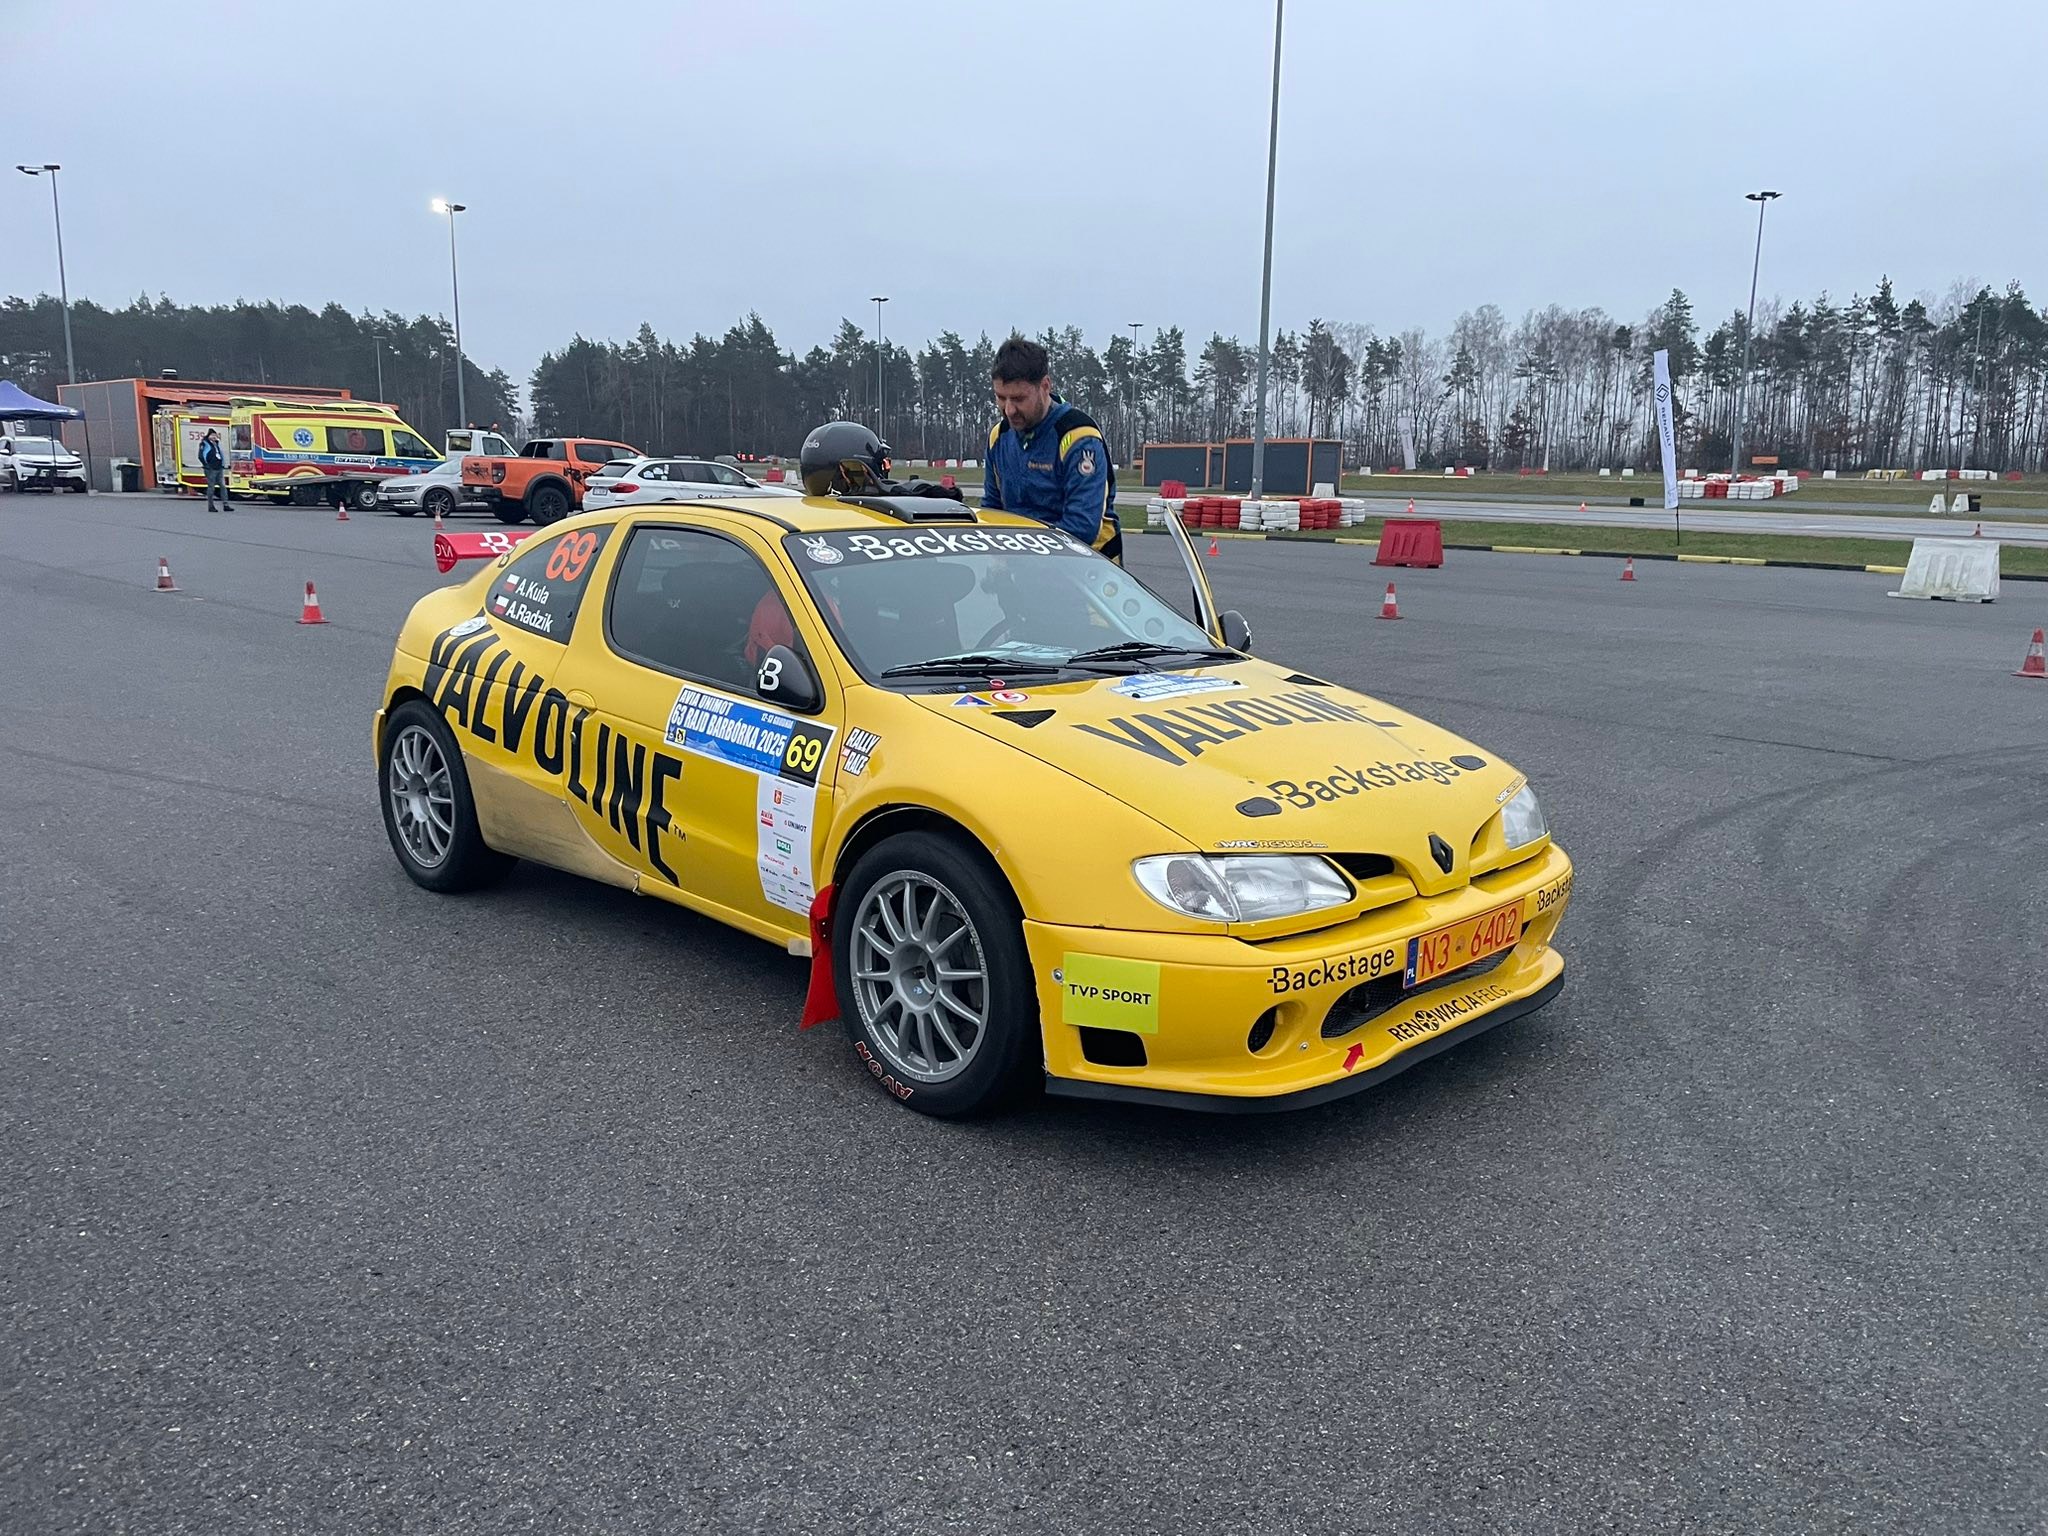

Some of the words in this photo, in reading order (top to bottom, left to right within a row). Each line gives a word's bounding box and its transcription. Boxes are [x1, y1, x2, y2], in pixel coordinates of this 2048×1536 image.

[1661, 407, 1672, 447] RENAULT
[545, 531, 598, 582] 69
[848, 528, 1064, 561] Backstage
[515, 578, 550, 605] A.Kula
[505, 600, 555, 633] A.Radzik
[679, 689, 702, 708] AVIA
[698, 694, 734, 716] UNIMOT
[422, 606, 683, 888] VALVOLINE
[671, 703, 688, 726] 63
[683, 706, 709, 733] RAJD
[705, 717, 761, 749] BARBÓRKA
[756, 729, 788, 757] 2025
[844, 727, 882, 754] RALLY
[1070, 691, 1403, 767] VALVOLINE
[786, 734, 822, 773] 69
[1272, 760, 1460, 809] Backstage
[1418, 933, 1451, 977] N3
[1470, 907, 1518, 958] 6402
[1267, 948, 1395, 994] Backstage
[1406, 968, 1416, 980] PL
[1069, 984, 1099, 999] TVP
[1102, 988, 1152, 1005] SPORT
[855, 1040, 914, 1101] AVON
